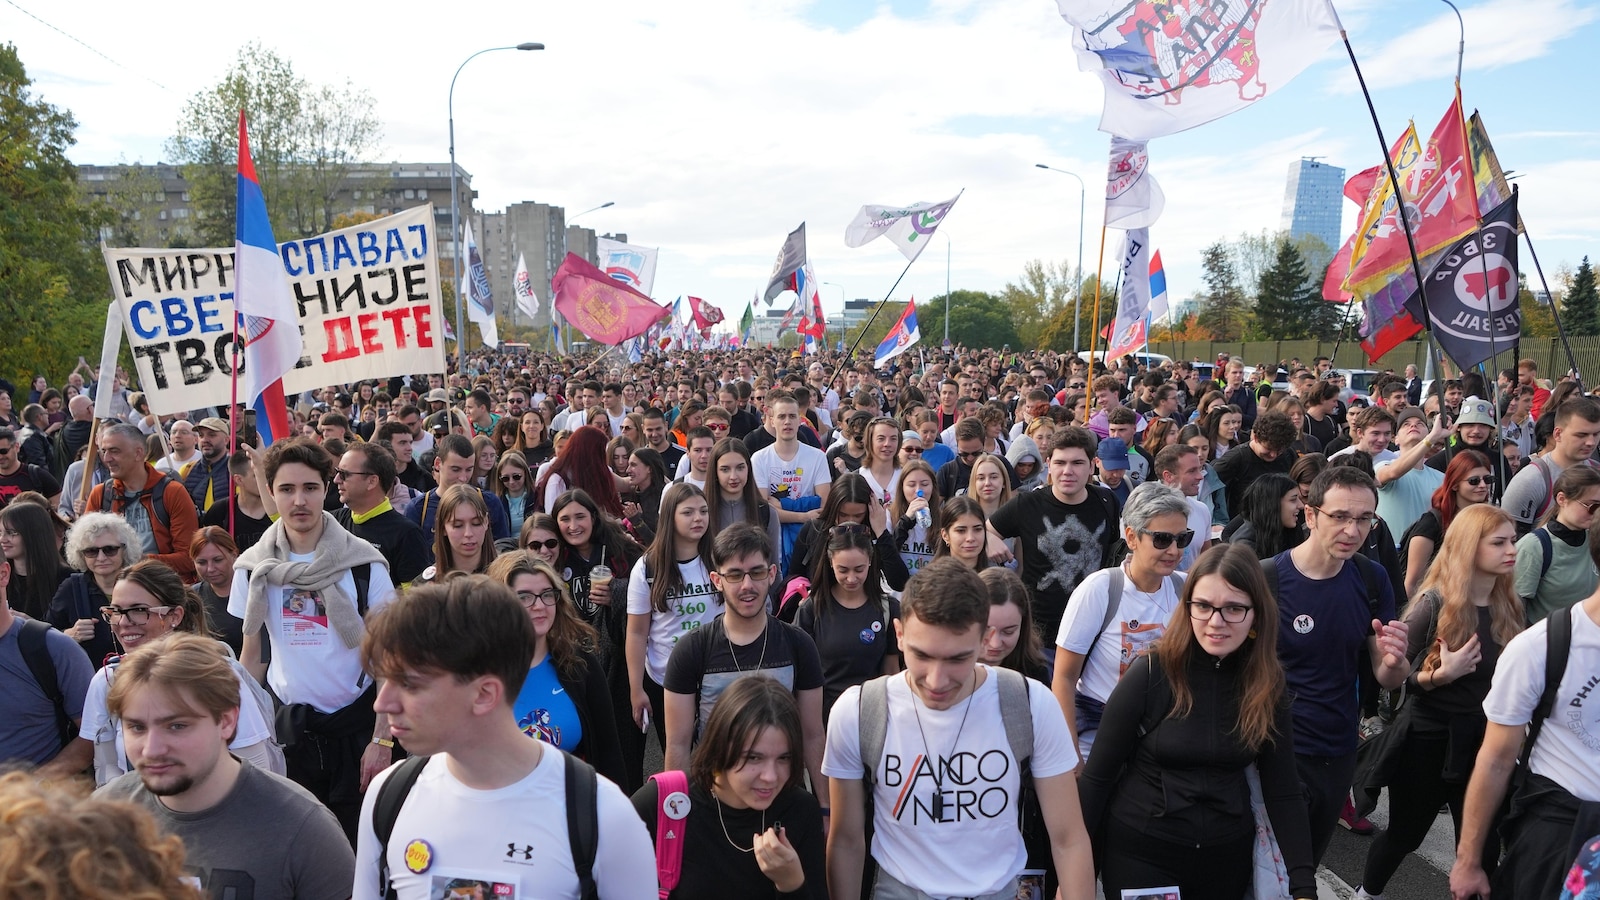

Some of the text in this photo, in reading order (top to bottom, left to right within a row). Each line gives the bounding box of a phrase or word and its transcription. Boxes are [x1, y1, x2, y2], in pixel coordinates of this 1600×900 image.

[116, 252, 235, 297] МИРН
[281, 223, 428, 277] СПАВАЈ
[293, 263, 429, 318] НИЈЕ
[322, 304, 433, 363] ДЕТЕ
[675, 602, 706, 617] 360
[681, 620, 701, 630] na
[885, 750, 1009, 787] BANCO
[914, 786, 1009, 826] NERO
[496, 885, 510, 894] 360
